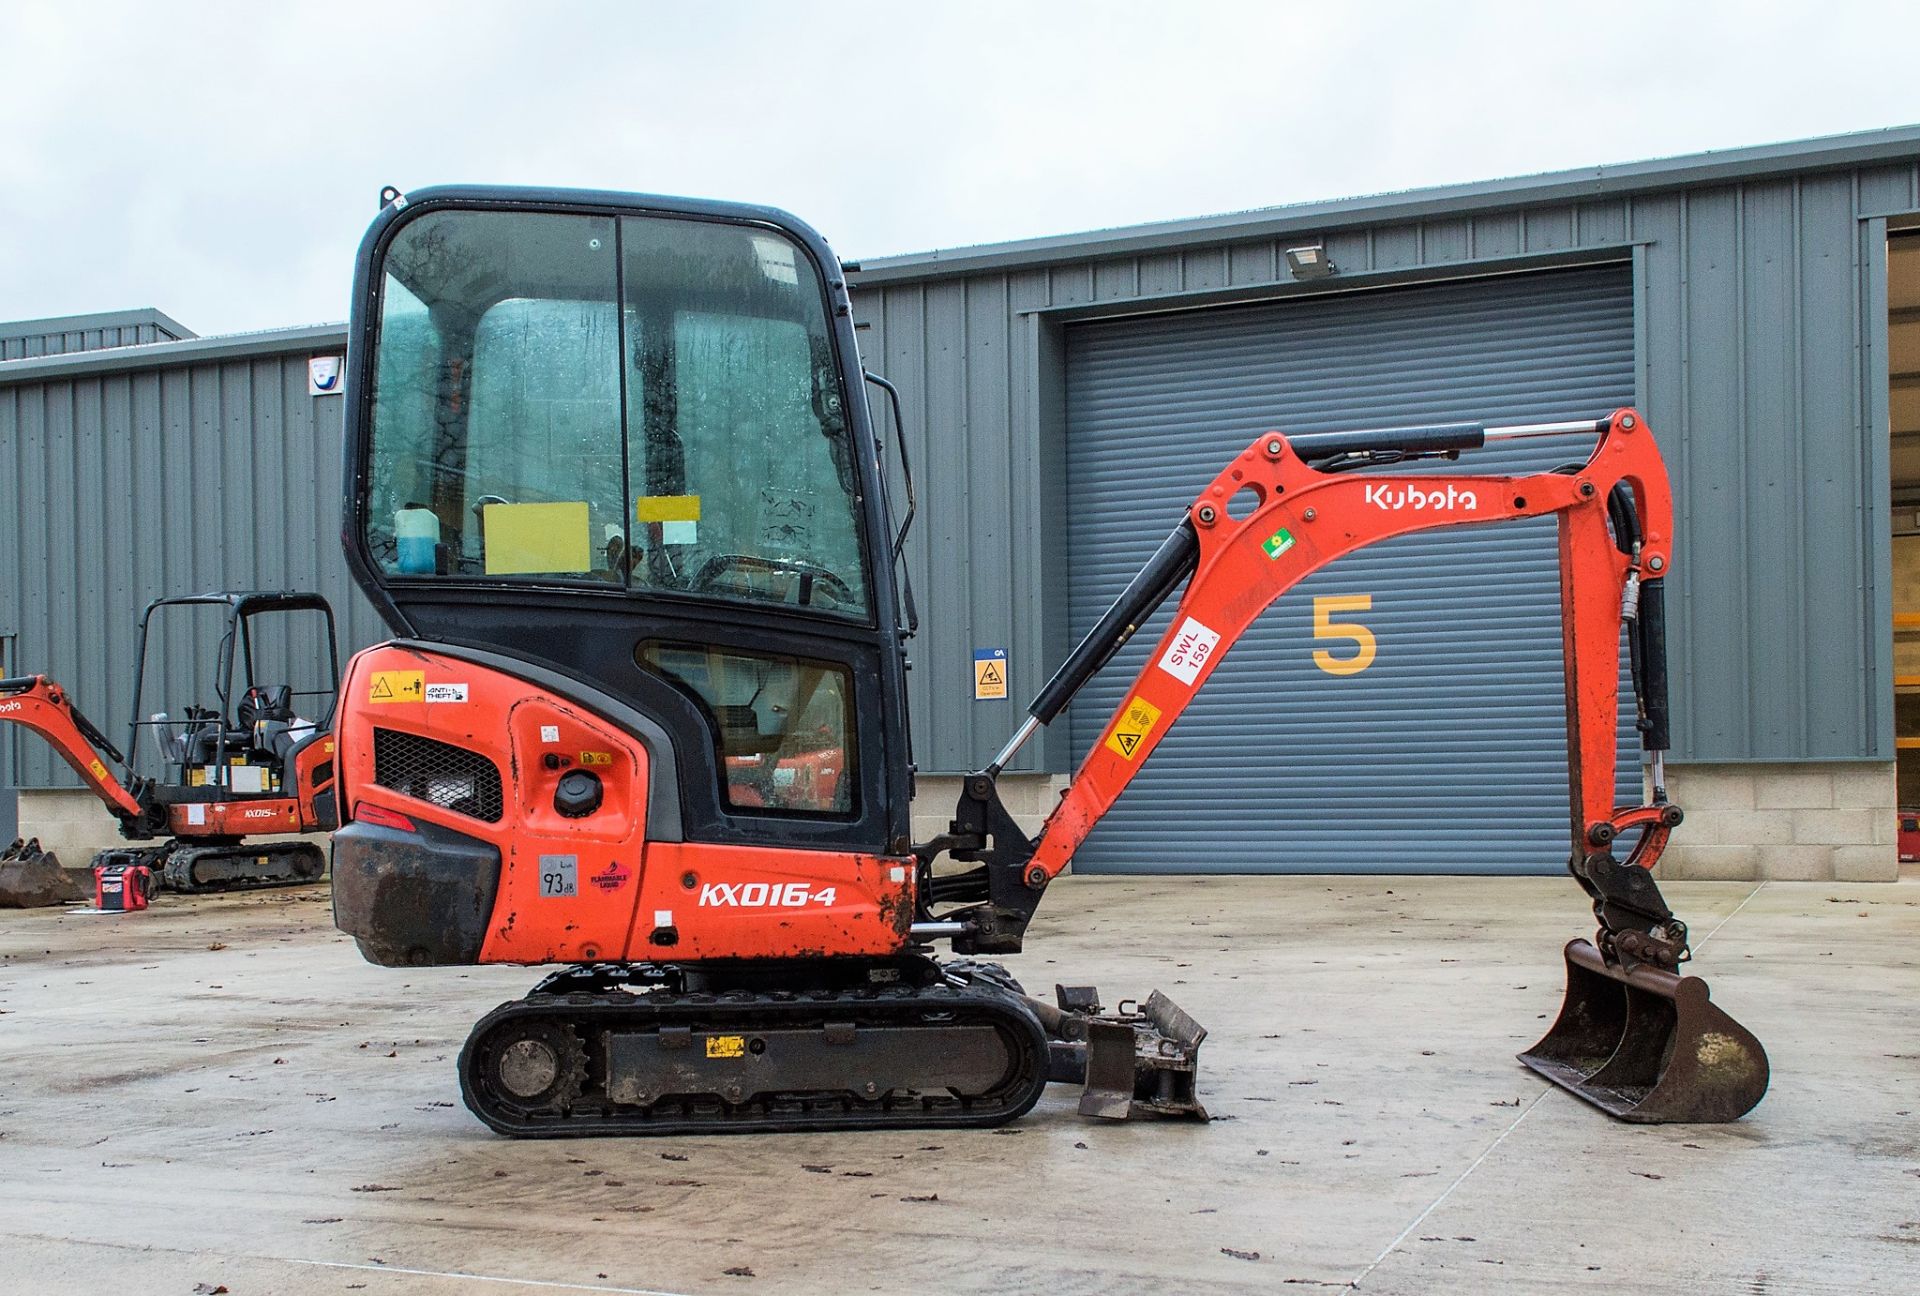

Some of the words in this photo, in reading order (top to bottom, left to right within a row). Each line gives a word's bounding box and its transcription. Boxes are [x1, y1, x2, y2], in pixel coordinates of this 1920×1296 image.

[1365, 484, 1477, 510] Kubota
[1312, 594, 1377, 676] 5
[1170, 633, 1199, 666] SWL
[1188, 643, 1210, 669] 159
[543, 873, 563, 894] 93
[698, 883, 837, 907] KX016-4
